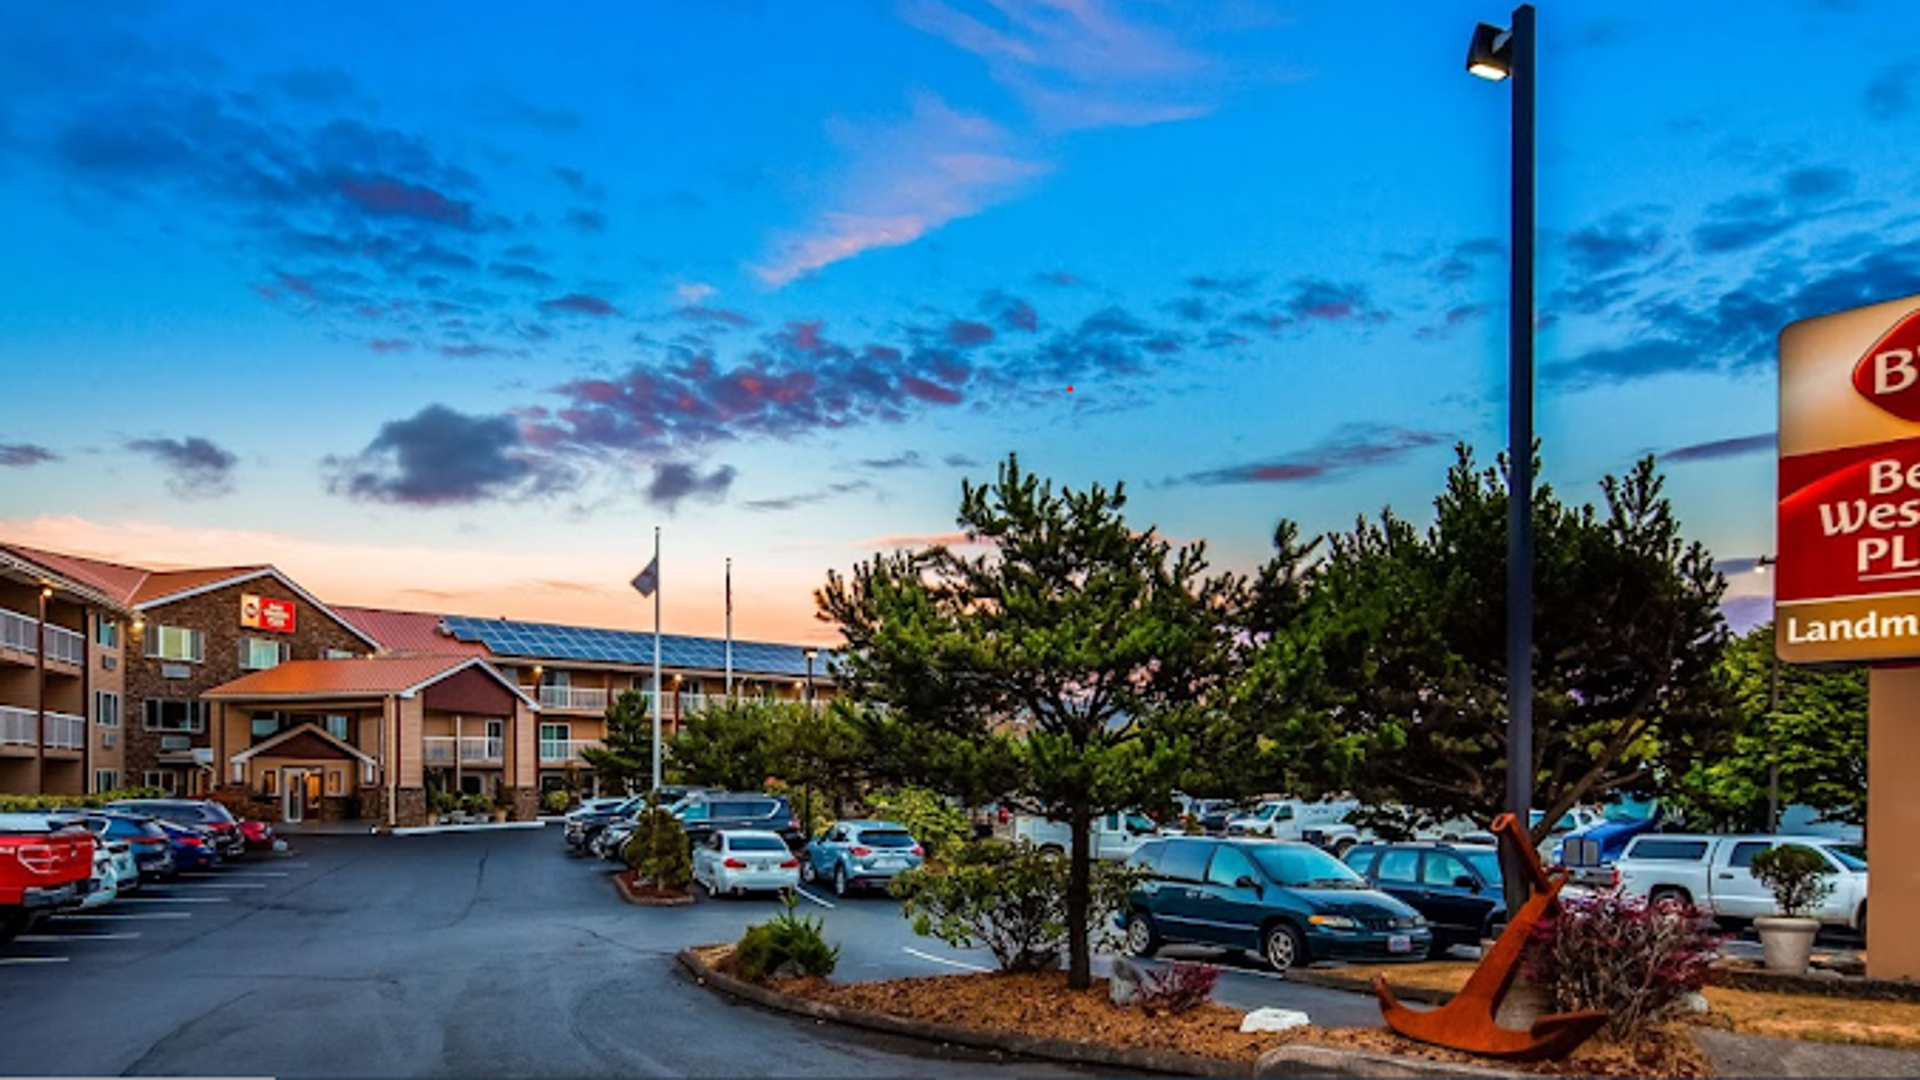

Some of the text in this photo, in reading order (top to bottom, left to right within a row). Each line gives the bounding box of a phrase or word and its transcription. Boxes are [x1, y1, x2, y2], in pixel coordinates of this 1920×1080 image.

[1875, 346, 1920, 394] B
[1819, 498, 1920, 536] Wes
[1858, 535, 1920, 573] PL
[1788, 610, 1919, 644] Landm
